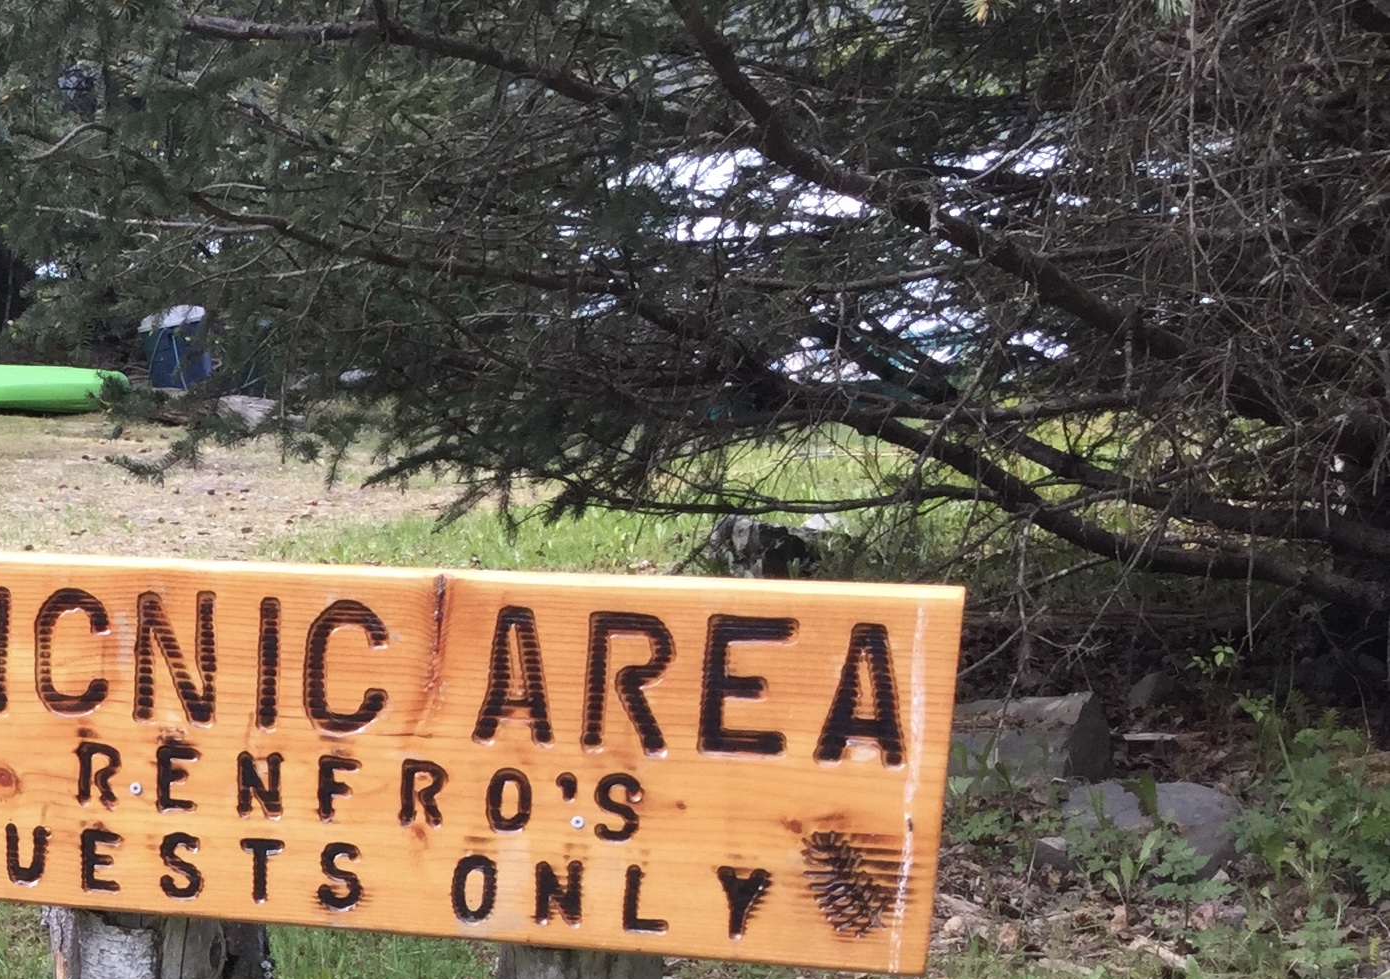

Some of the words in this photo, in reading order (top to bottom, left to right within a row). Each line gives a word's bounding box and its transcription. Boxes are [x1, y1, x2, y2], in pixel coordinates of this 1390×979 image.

[471, 603, 907, 768] AREA
[75, 740, 646, 843] RENFRO'S
[450, 854, 774, 942] ONLY
